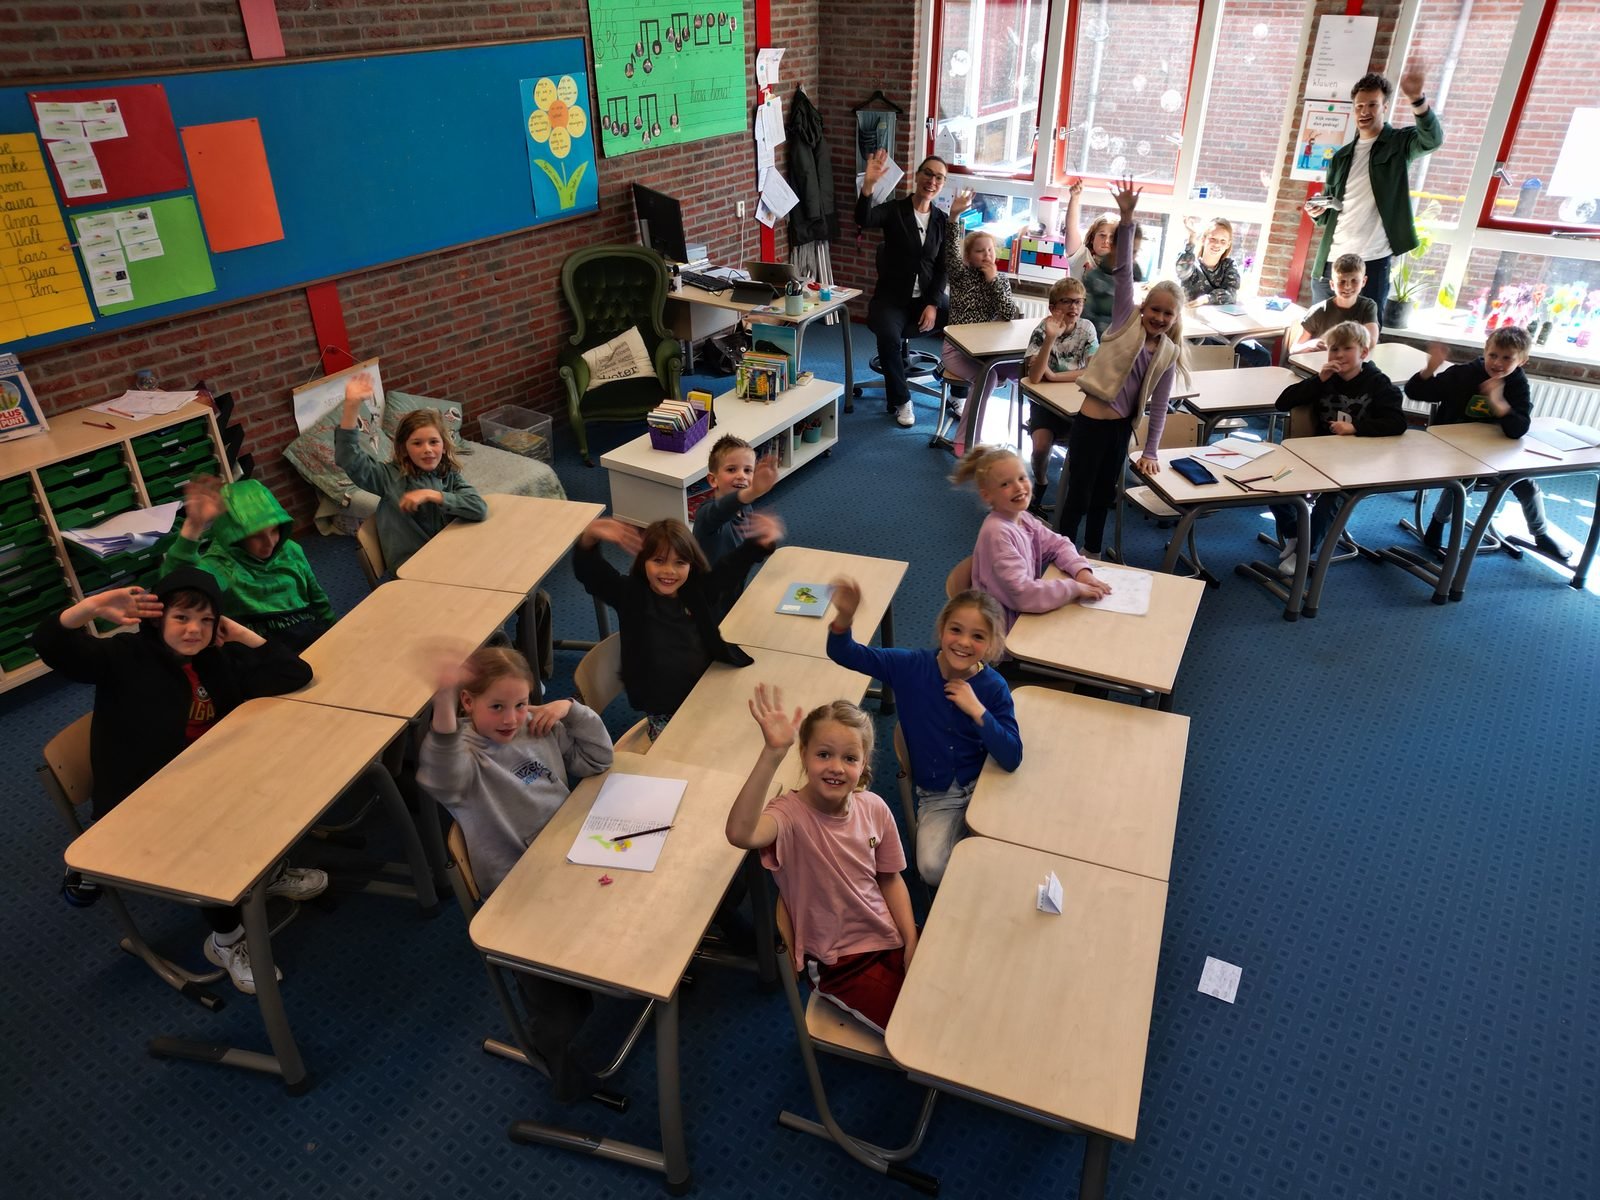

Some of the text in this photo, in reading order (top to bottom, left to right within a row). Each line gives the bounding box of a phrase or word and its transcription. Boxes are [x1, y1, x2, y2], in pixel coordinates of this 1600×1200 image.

[3, 214, 40, 230] Anna
[5, 230, 43, 247] Walt
[17, 248, 48, 264] Lars
[1, 416, 25, 427] PUNT
